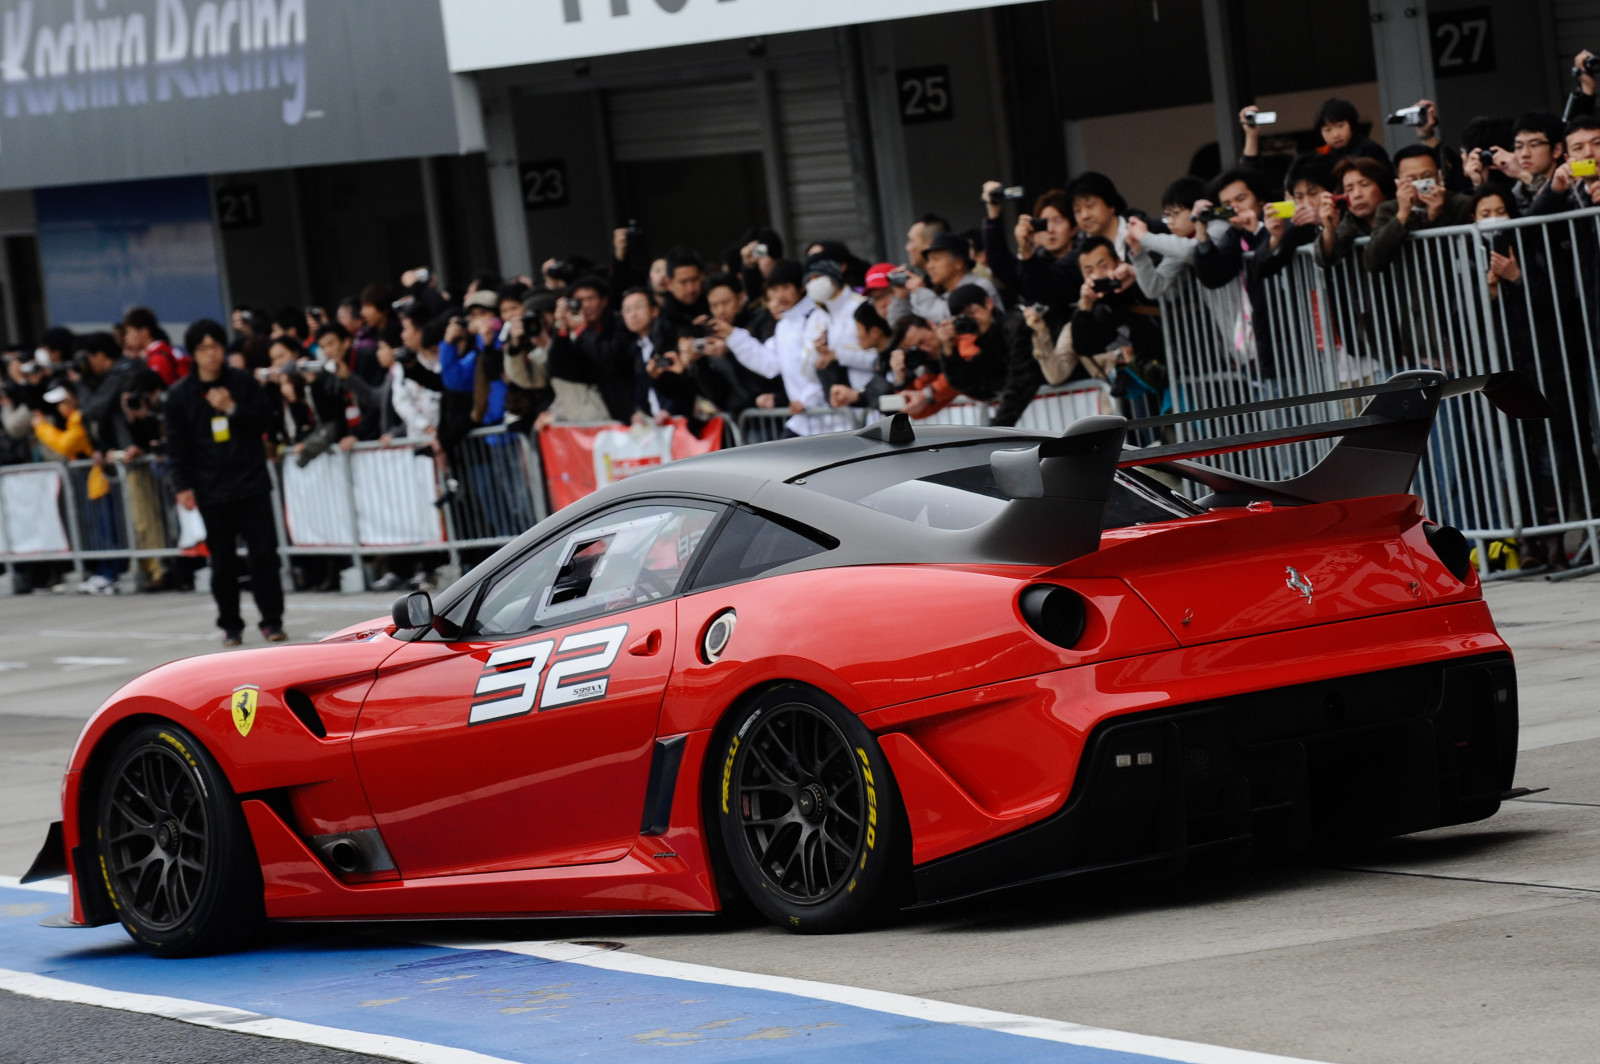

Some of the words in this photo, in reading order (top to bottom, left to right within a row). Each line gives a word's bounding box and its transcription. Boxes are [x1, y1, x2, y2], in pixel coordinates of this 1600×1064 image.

[153, 0, 306, 125] Racing
[1436, 20, 1487, 67] 27
[902, 76, 948, 116] 25
[221, 194, 254, 223] 21
[524, 169, 565, 202] 23
[467, 622, 630, 727] 32
[722, 735, 741, 815] PIRELLI
